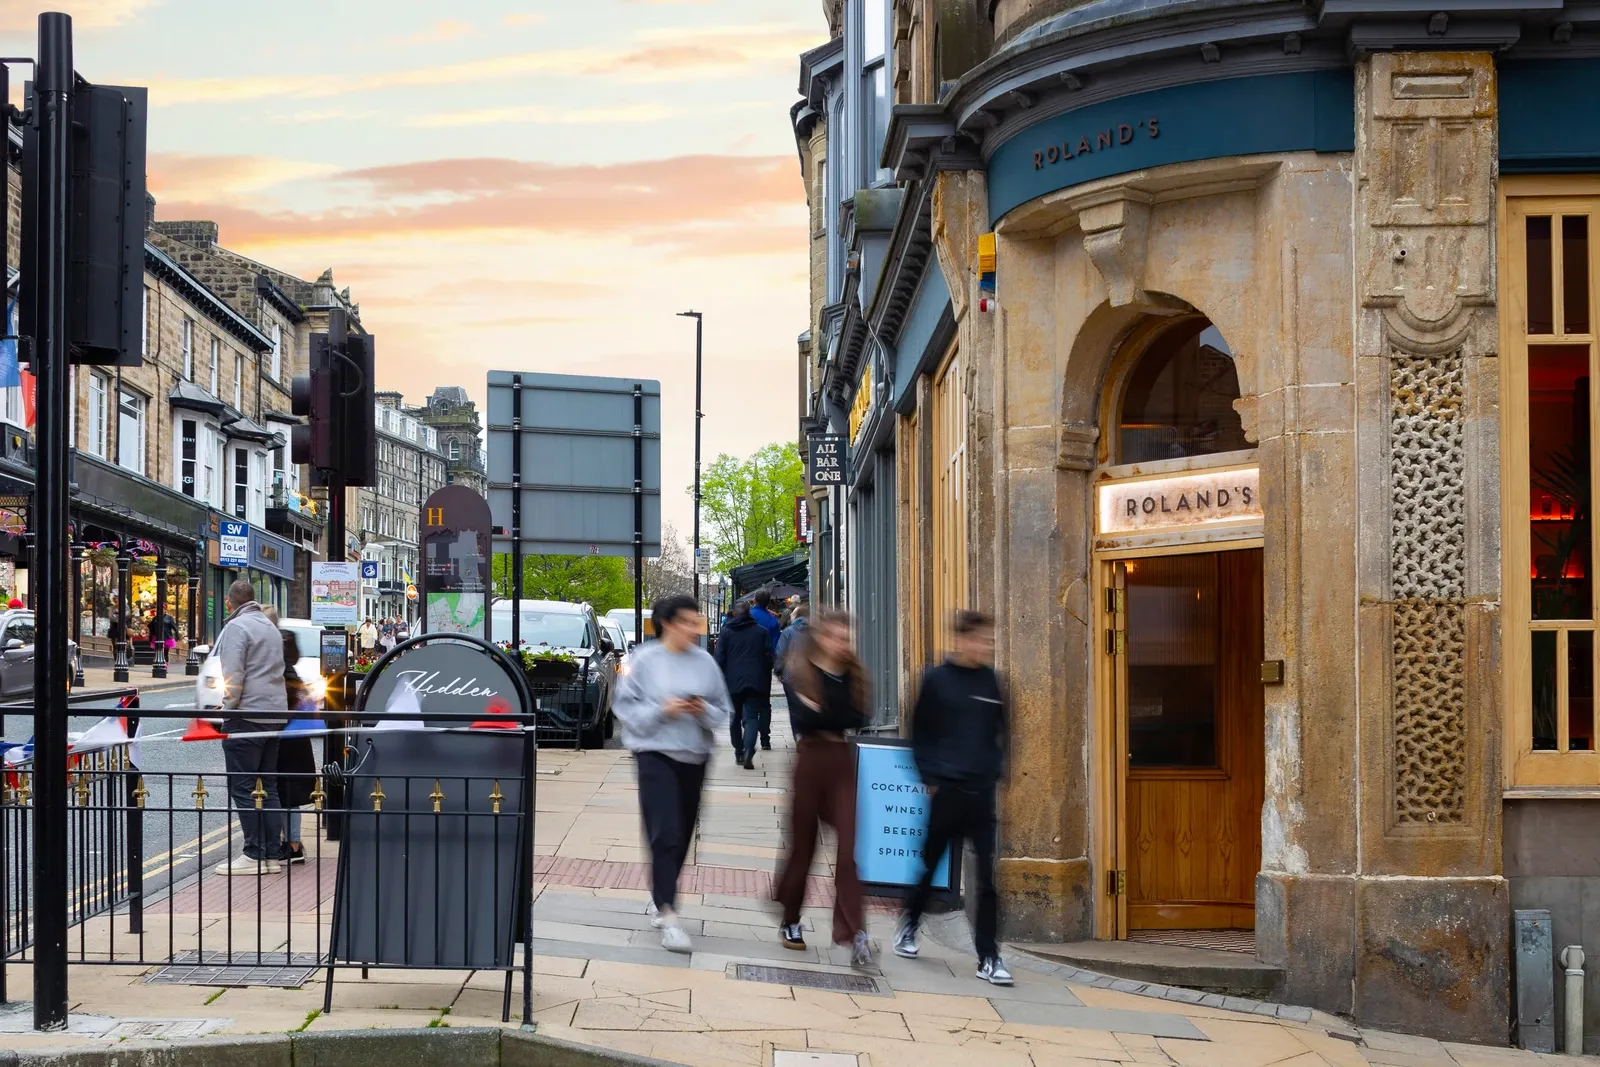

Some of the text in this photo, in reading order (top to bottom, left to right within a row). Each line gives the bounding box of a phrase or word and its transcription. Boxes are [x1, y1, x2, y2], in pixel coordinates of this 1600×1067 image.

[1032, 118, 1160, 170] ROLAND'S
[815, 443, 837, 454] ALL
[816, 456, 839, 467] BAR
[815, 470, 841, 481] ONE
[1127, 486, 1252, 516] ROLAND'S
[427, 507, 444, 526] H
[227, 524, 243, 535] SW
[222, 542, 246, 552] To Let
[396, 669, 498, 697] Hidden
[871, 783, 932, 795] COCKTAIL
[885, 804, 923, 815] WINES
[883, 826, 923, 837] BEERS
[878, 847, 925, 858] SPIRITS
